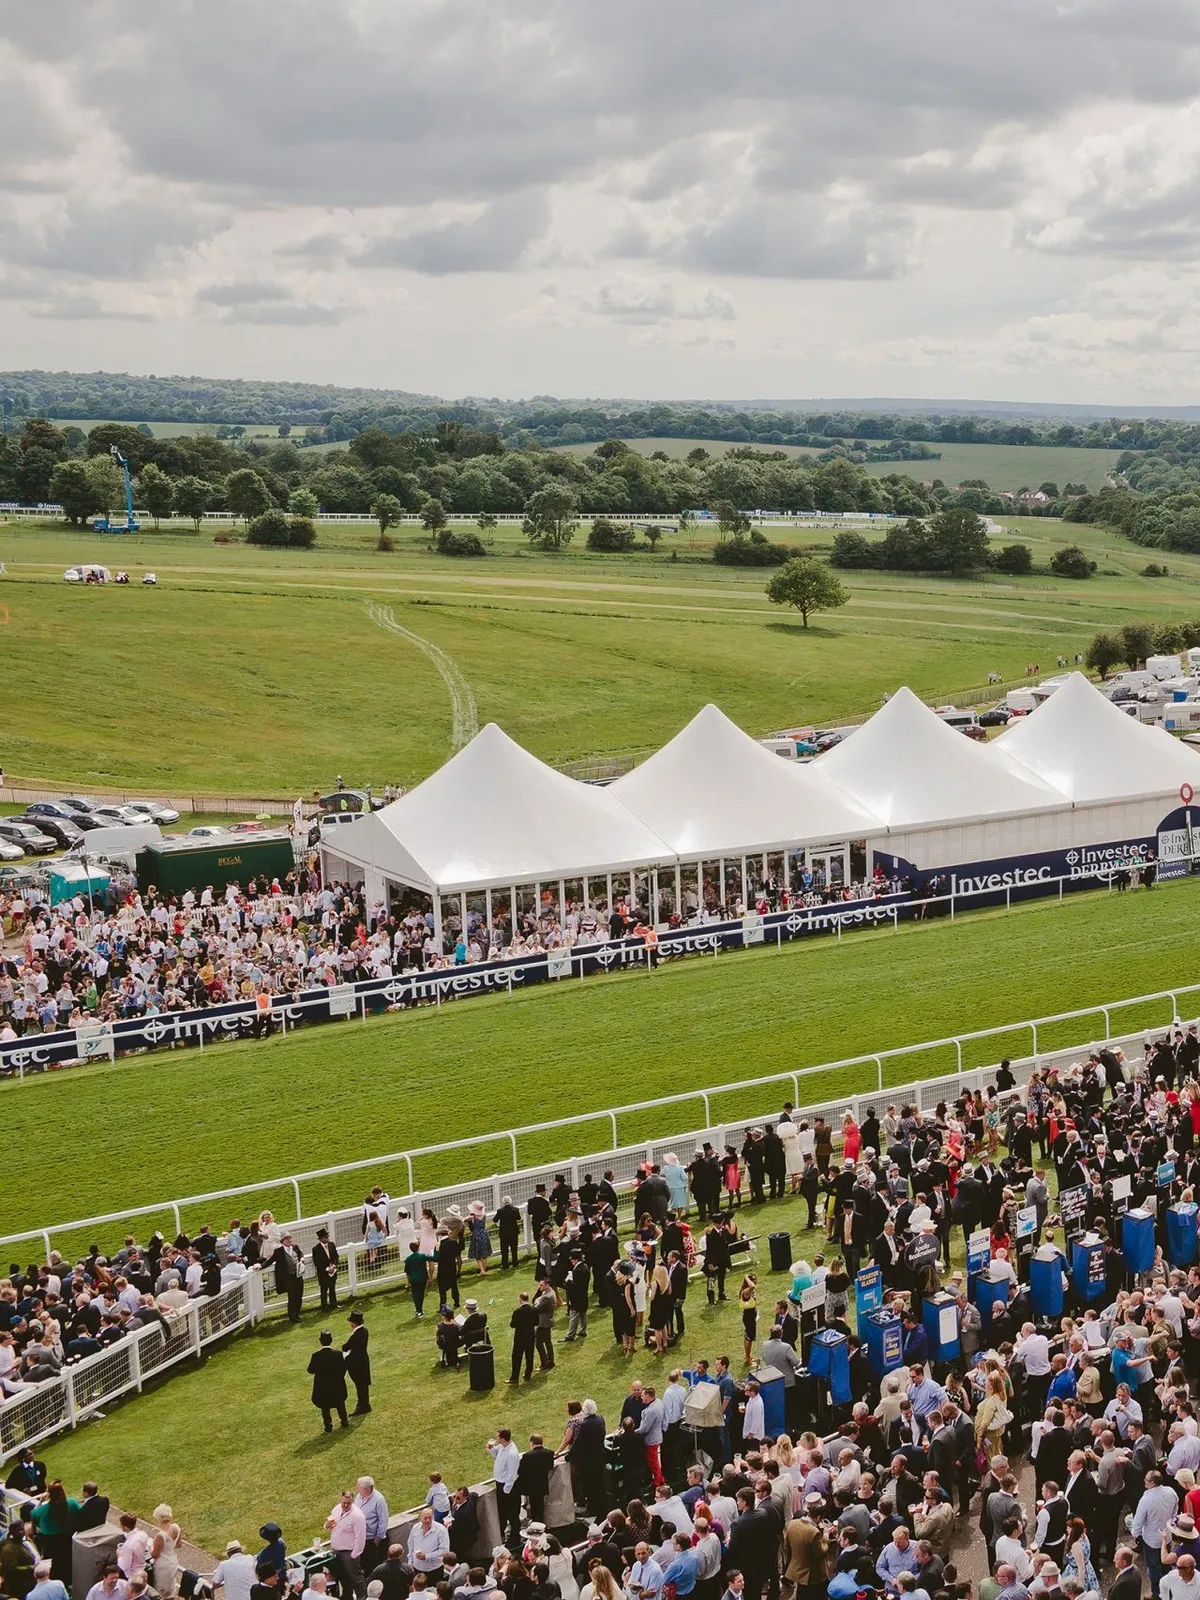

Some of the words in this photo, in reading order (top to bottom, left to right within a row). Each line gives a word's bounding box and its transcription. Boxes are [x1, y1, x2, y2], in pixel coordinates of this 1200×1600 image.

[1081, 843, 1147, 863] Investec
[951, 866, 1051, 896] Investec
[807, 905, 899, 931] Investec
[620, 932, 712, 964] Inestec
[410, 969, 525, 1000] Investec
[908, 1247, 937, 1260] Bookmakers
[914, 1243, 930, 1252] Apollo
